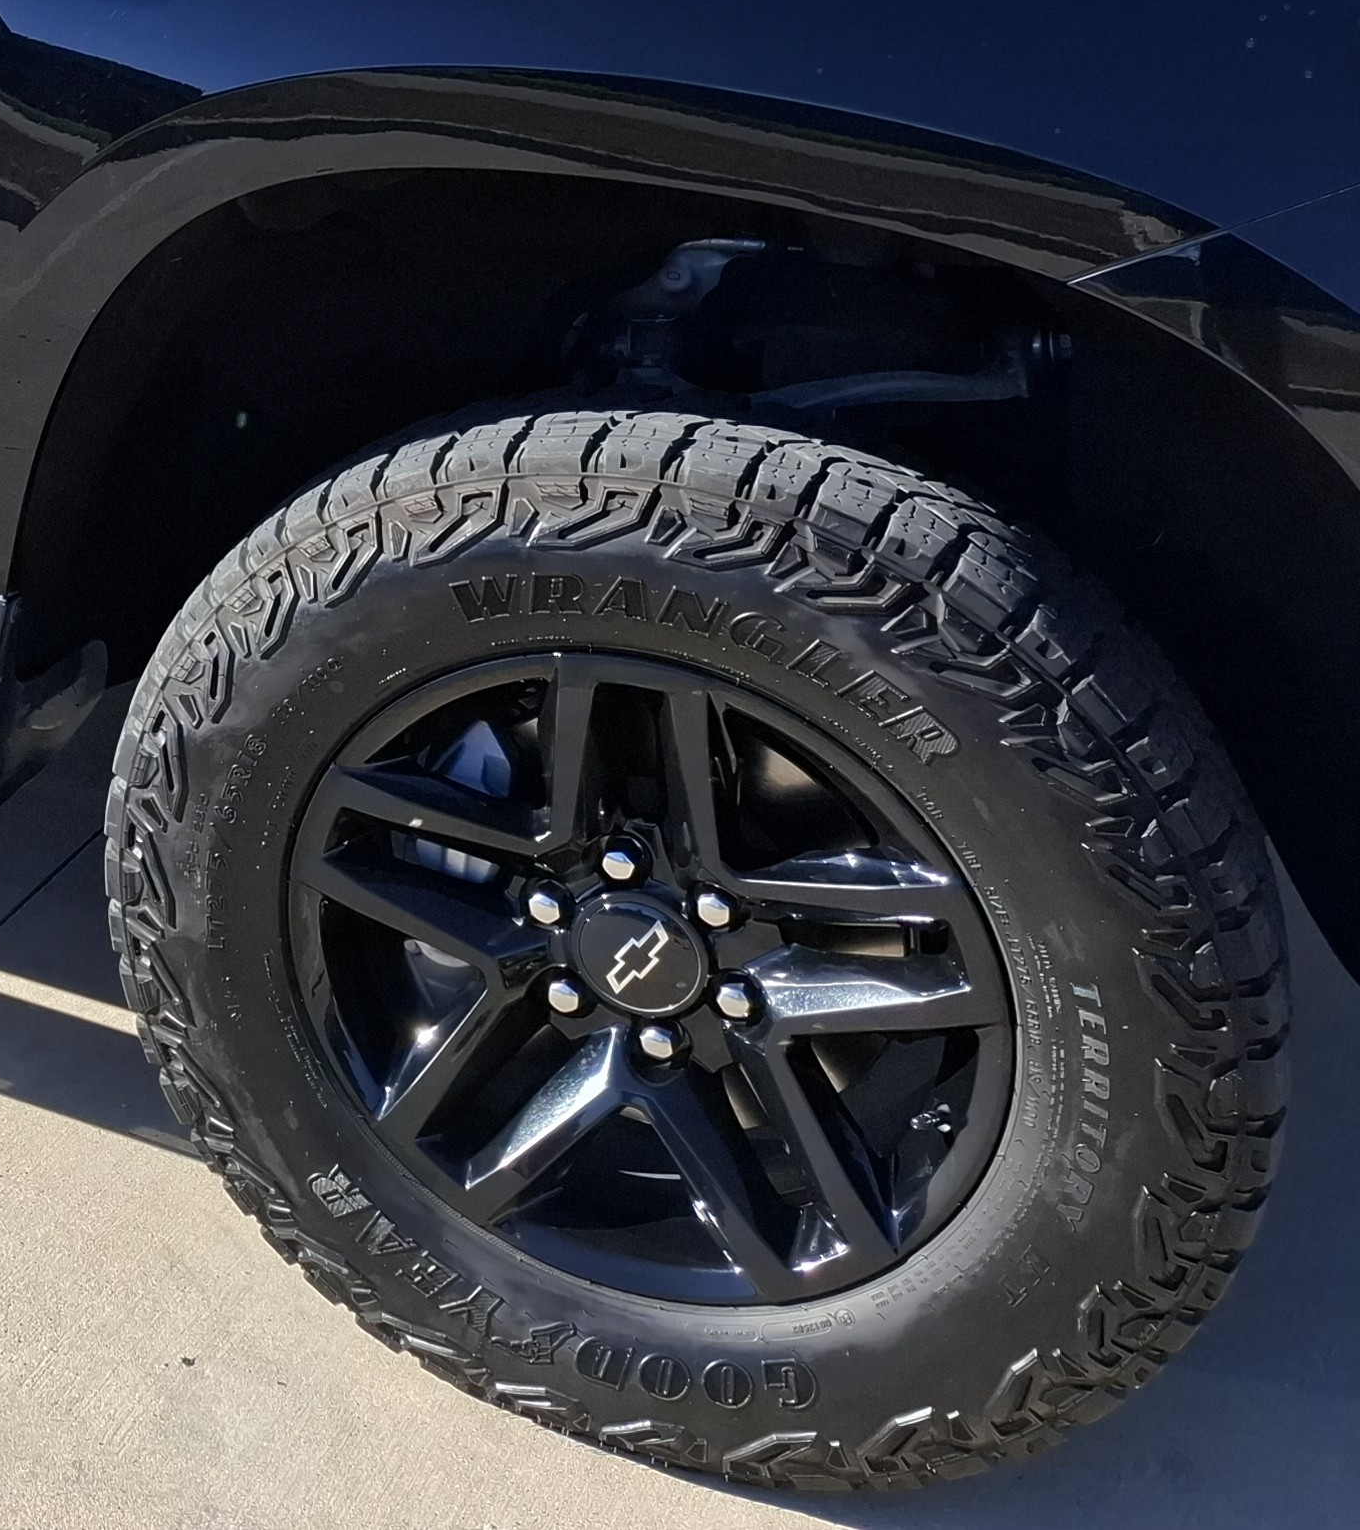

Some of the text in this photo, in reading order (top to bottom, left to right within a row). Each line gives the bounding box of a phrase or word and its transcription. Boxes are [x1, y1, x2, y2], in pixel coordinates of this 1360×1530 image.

[448, 571, 961, 767] WRANGLER
[1054, 981, 1113, 1233] TERRITORY
[307, 1164, 819, 1409] GOODYEAR
